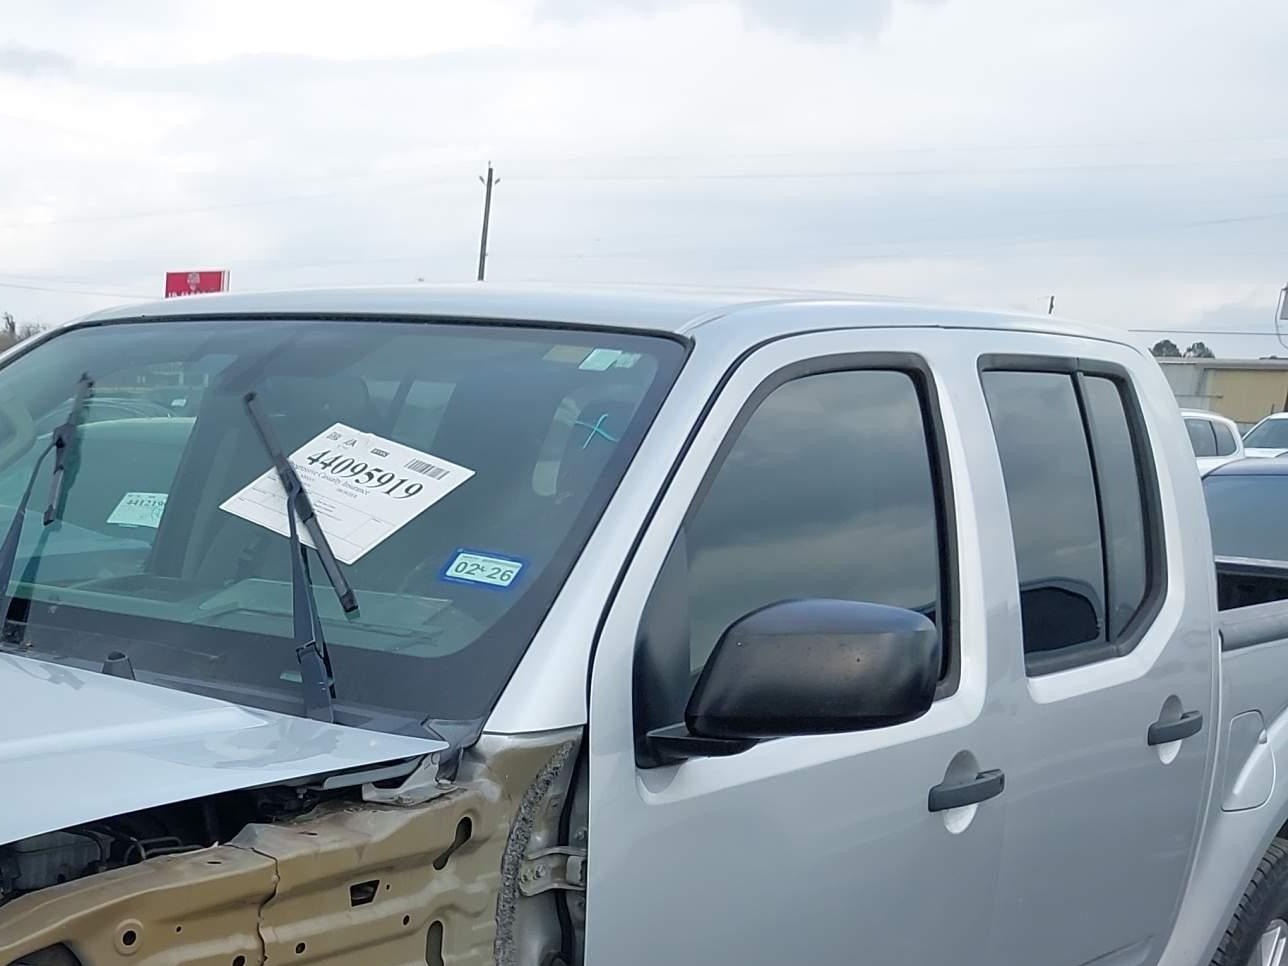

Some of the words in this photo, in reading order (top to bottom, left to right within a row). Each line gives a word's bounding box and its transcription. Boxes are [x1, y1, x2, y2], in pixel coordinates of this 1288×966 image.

[306, 449, 424, 499] 44095919
[454, 561, 481, 576] 02
[485, 567, 514, 582] 26
